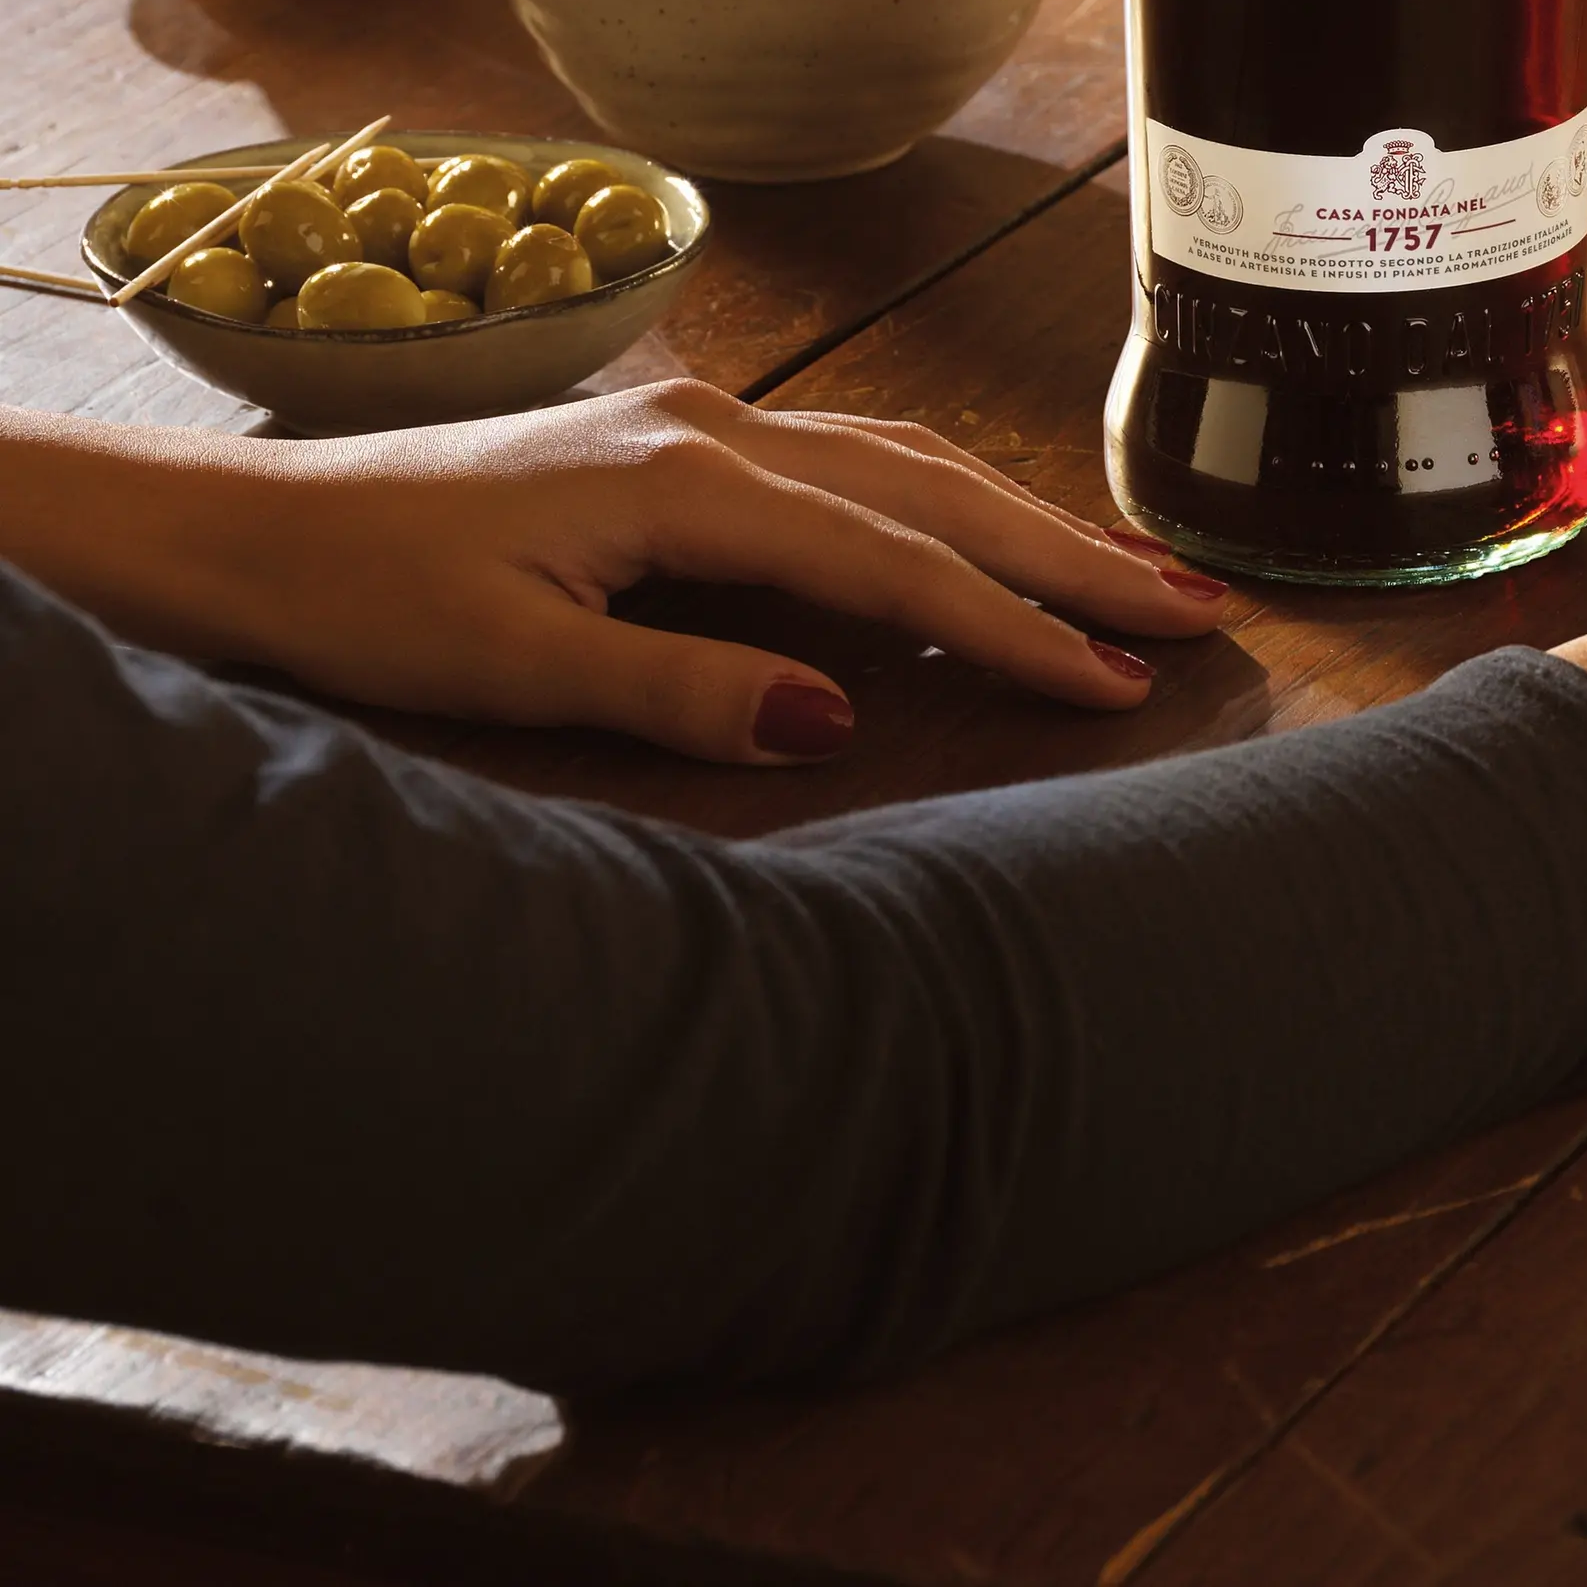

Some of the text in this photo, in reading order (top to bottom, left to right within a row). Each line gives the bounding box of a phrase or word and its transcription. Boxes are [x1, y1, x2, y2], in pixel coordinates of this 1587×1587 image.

[1315, 197, 1487, 221] CASA FONDATA NEL
[1188, 226, 1574, 279] A BASE DI ARTEMISIA E INFUSI DI PIANTE AROMATICHE SELEZIONATE
[1192, 218, 1570, 269] VERMOUTH ROSSO PRODOTTO SECONDO LA TRADIZIONE ITALIANA
[1365, 223, 1443, 252] 1757
